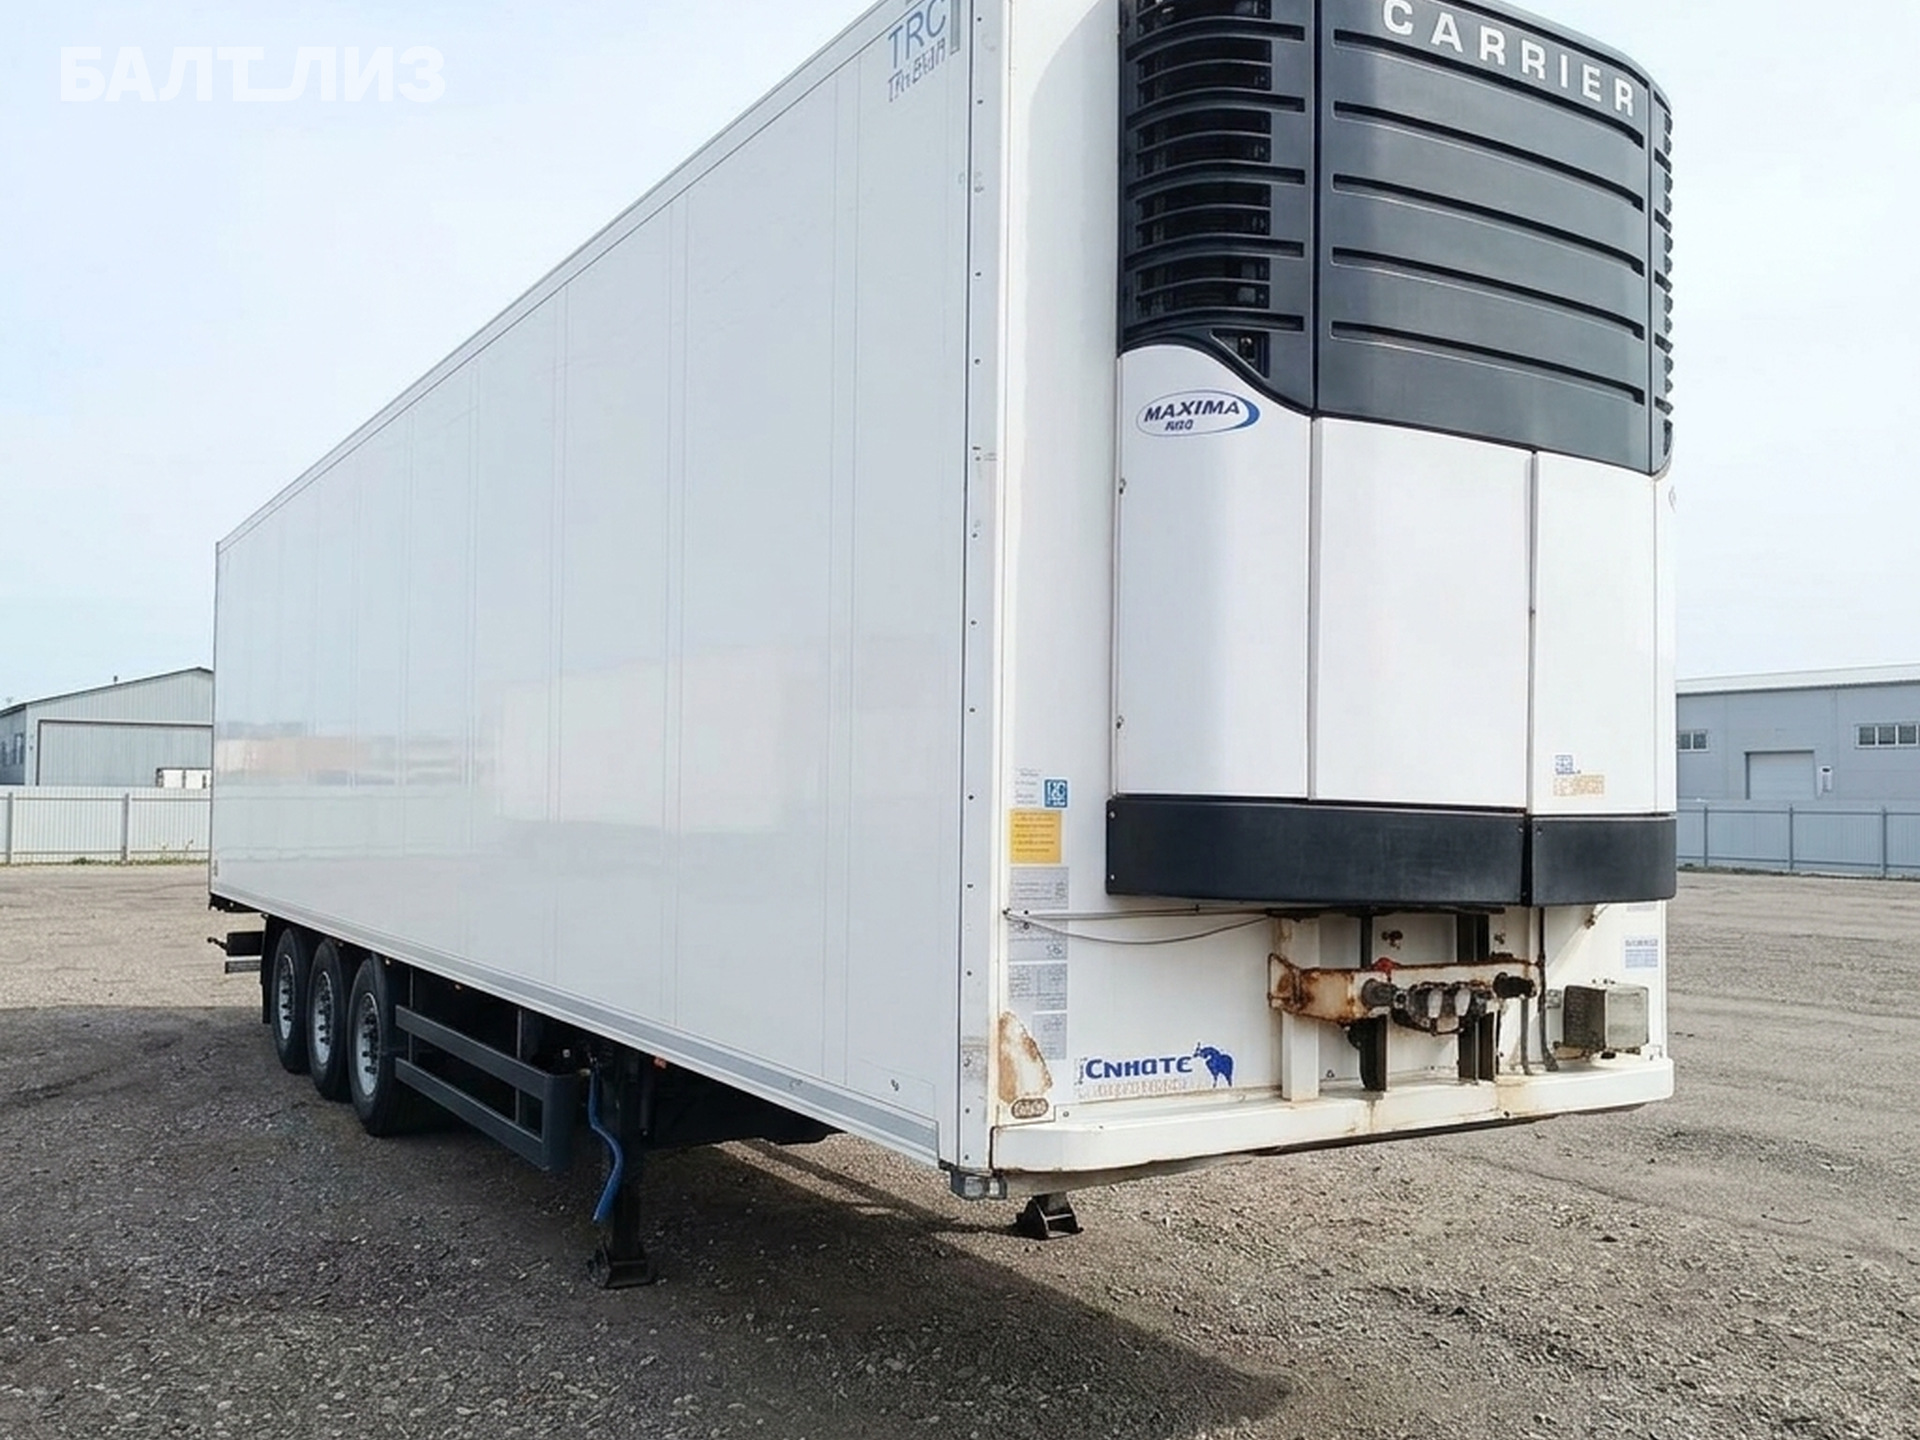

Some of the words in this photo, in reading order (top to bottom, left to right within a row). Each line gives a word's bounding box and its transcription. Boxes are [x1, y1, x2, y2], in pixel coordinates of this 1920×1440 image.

[888, 0, 946, 69] TRC
[1383, 0, 1635, 117] CARRIER
[1144, 400, 1240, 422] MAXIMA
